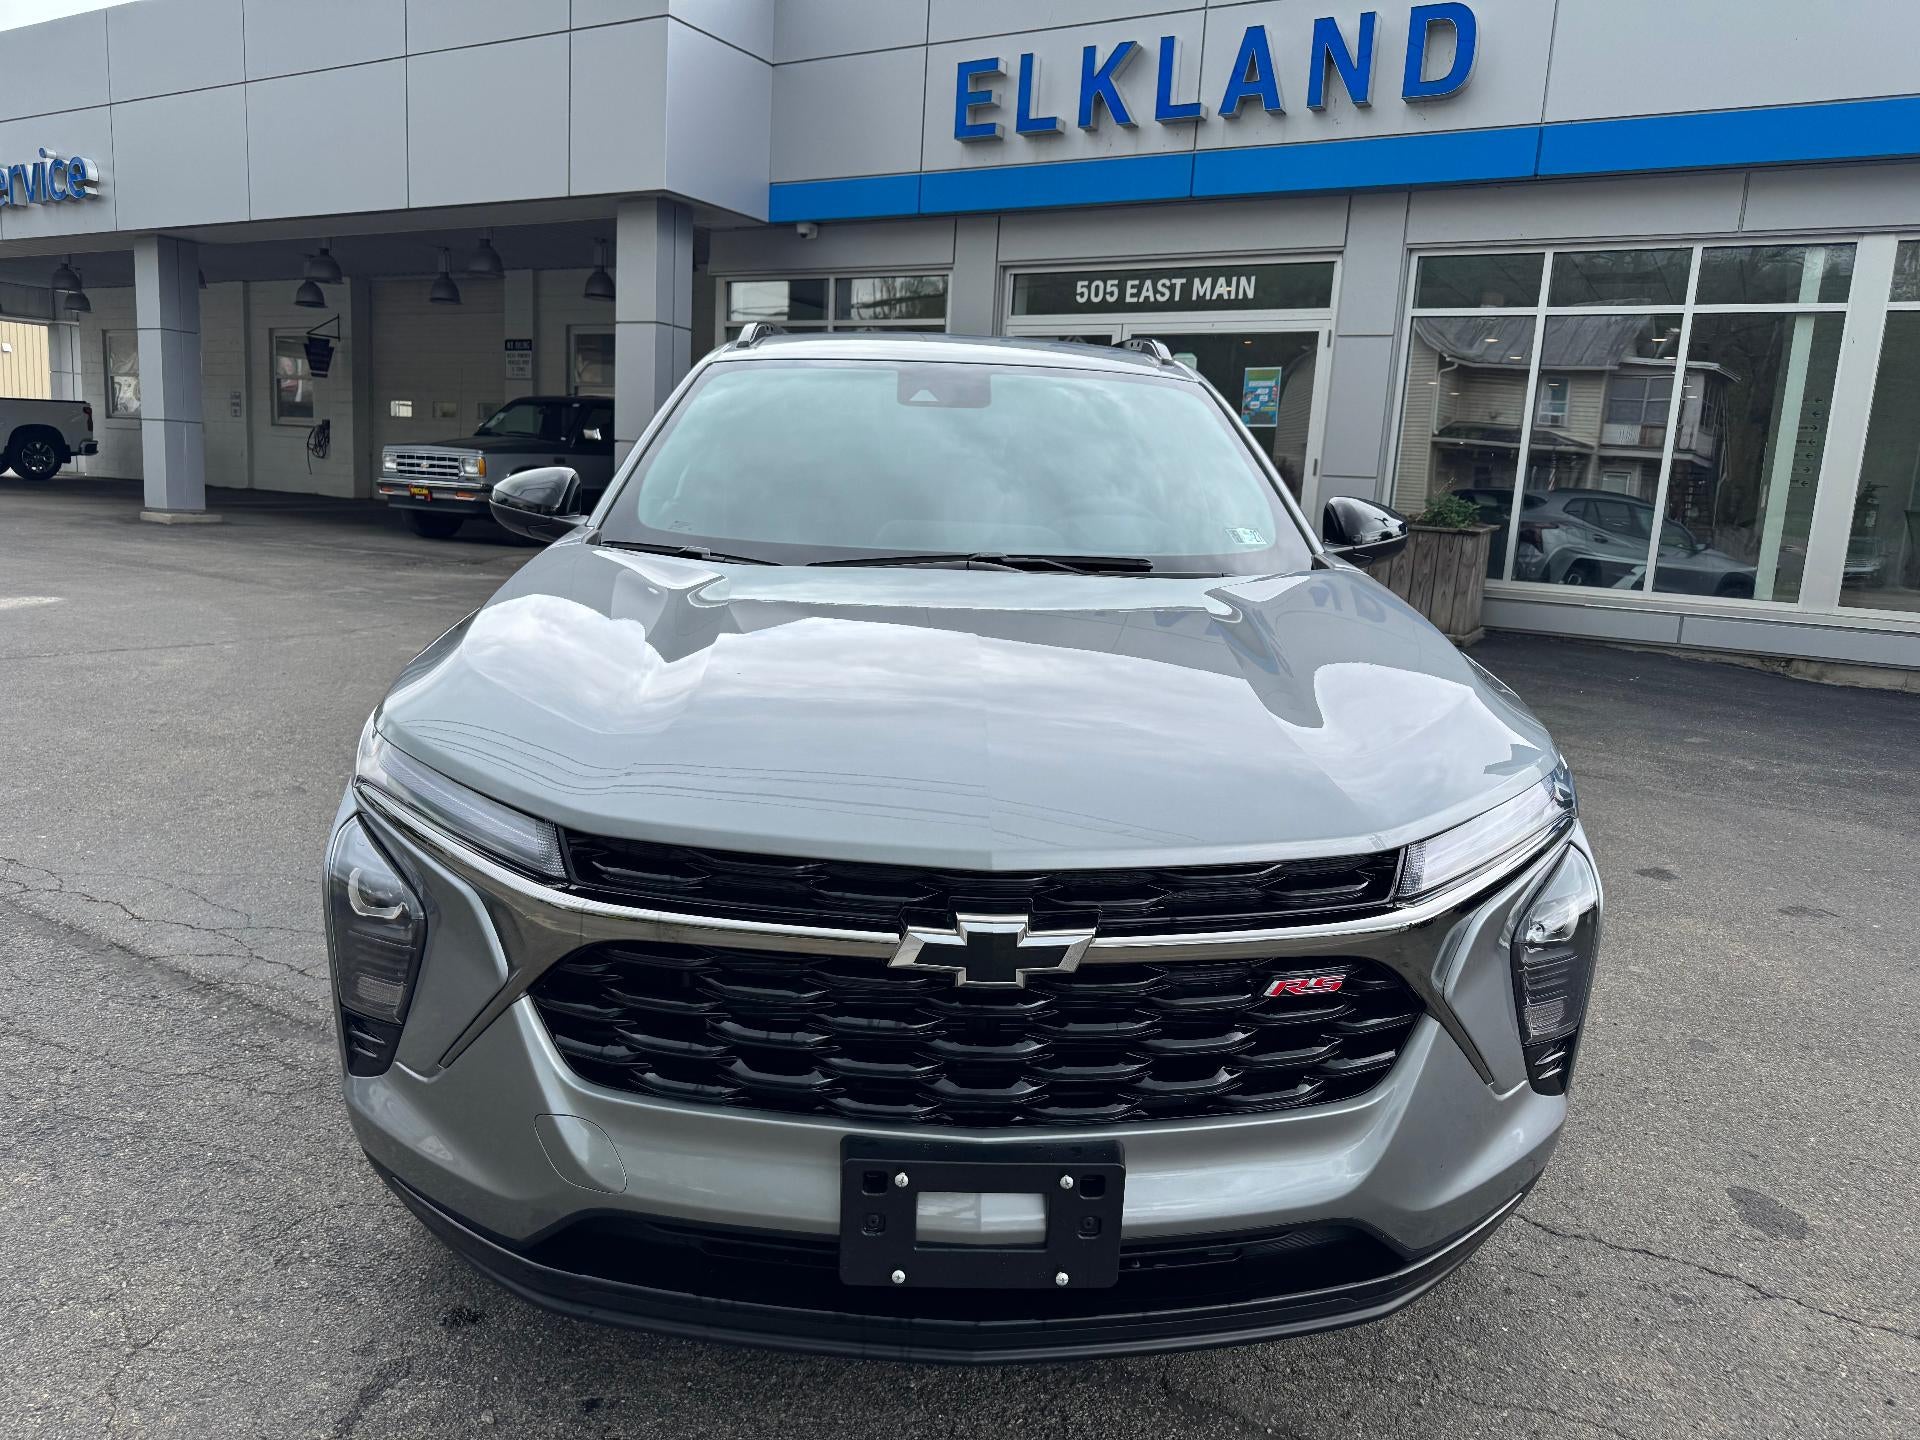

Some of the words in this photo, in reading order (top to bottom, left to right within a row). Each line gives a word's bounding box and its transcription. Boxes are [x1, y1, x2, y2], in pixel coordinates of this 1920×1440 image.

[954, 2, 1478, 142] ELKLAND
[1076, 280, 1119, 303] 505
[1125, 278, 1187, 303] EAST
[1191, 275, 1256, 301] MAIN
[1263, 975, 1346, 997] RS
